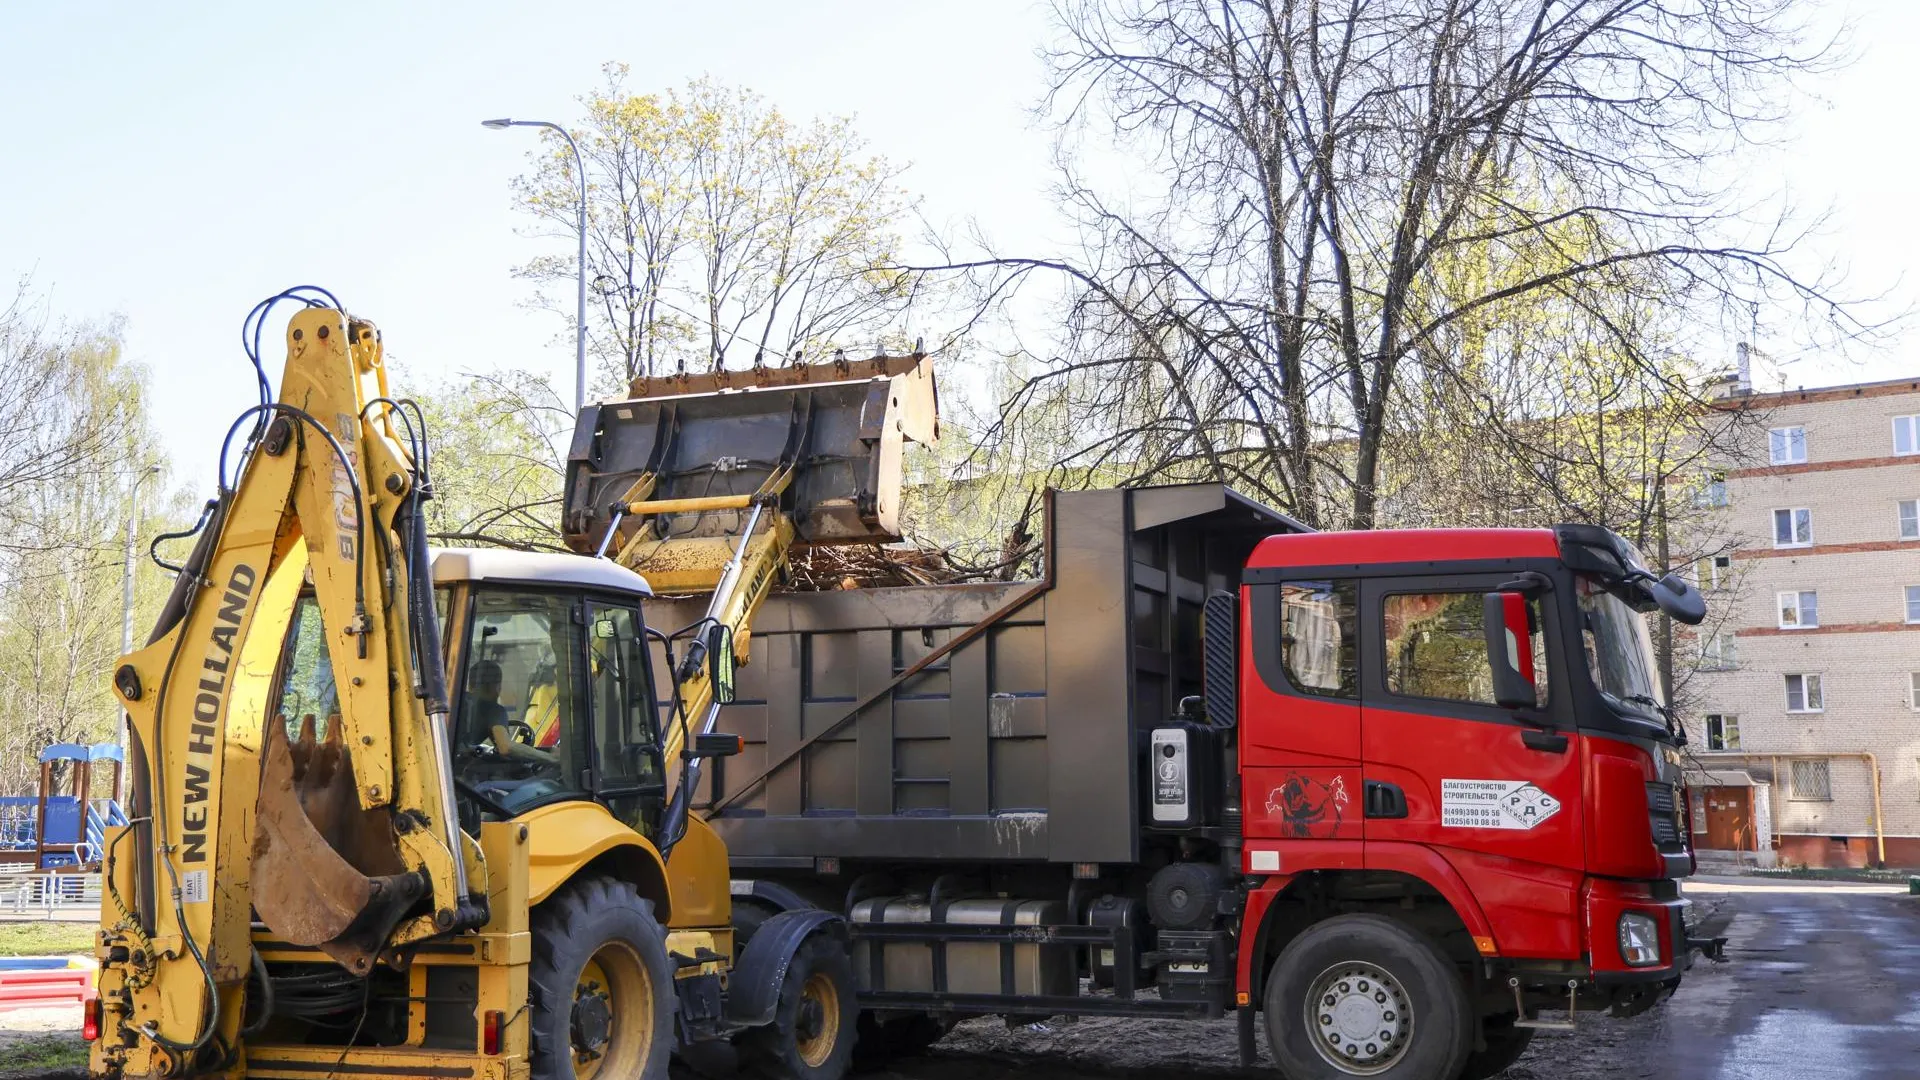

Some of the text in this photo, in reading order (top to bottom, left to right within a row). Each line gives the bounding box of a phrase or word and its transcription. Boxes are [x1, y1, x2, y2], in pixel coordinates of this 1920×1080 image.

[182, 563, 256, 863] NEW HOLLAND
[1443, 782, 1507, 791] БЛАГОУСТРОЙСТВО
[1443, 791, 1498, 800] СТРОИТЕЛЬСТВО
[1480, 809, 1490, 817] 05
[1501, 803, 1528, 825] РЕГИОН
[1480, 818, 1490, 826] 08
